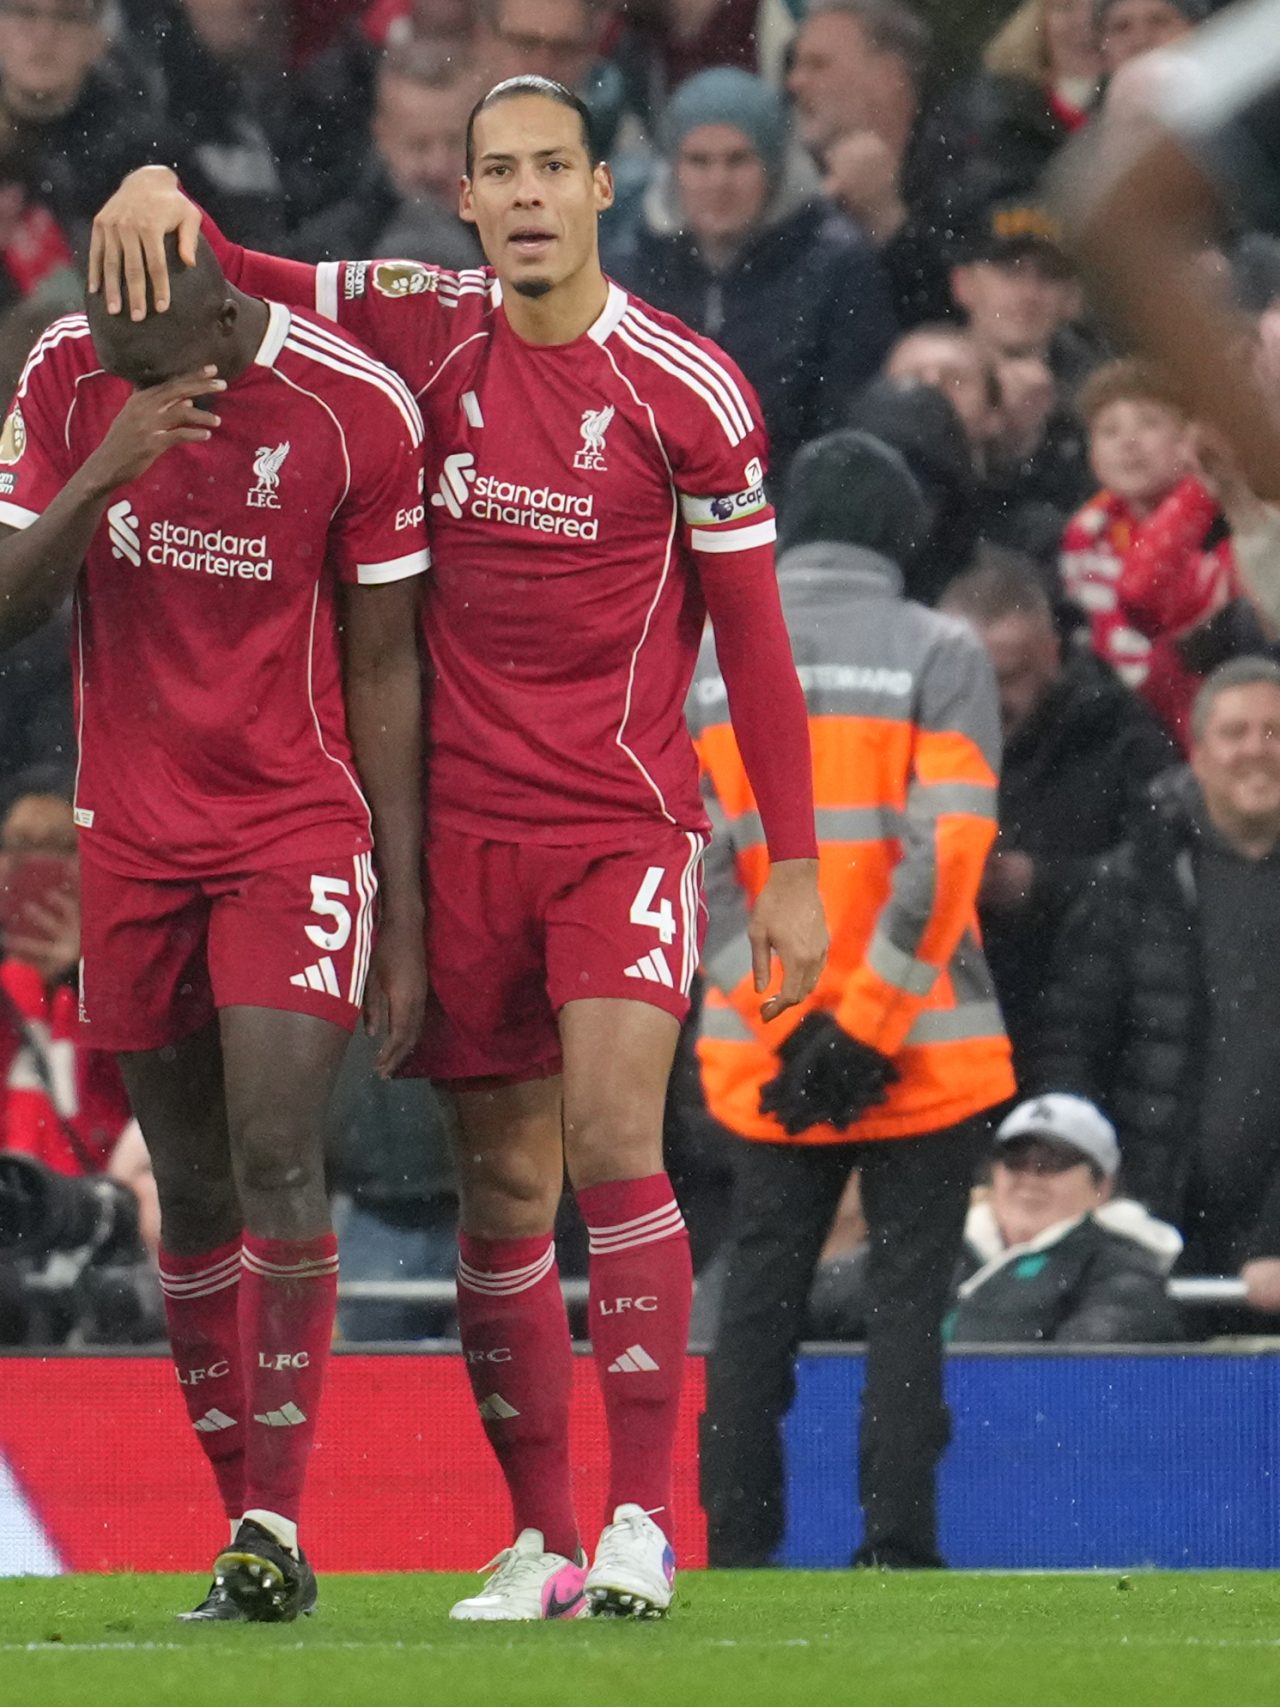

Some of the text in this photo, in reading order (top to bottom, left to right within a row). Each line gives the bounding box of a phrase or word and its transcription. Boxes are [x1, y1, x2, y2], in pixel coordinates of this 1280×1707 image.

[474, 476, 593, 517] standard
[736, 488, 763, 507] Cap
[471, 499, 598, 540] chartered
[149, 520, 266, 557] standard
[147, 544, 272, 581] chartered
[304, 874, 351, 951] 5
[630, 866, 676, 945] 4
[600, 1296, 658, 1316] LFC
[175, 1360, 230, 1385] LFC
[259, 1351, 310, 1371] LFC
[468, 1347, 512, 1364] FC
